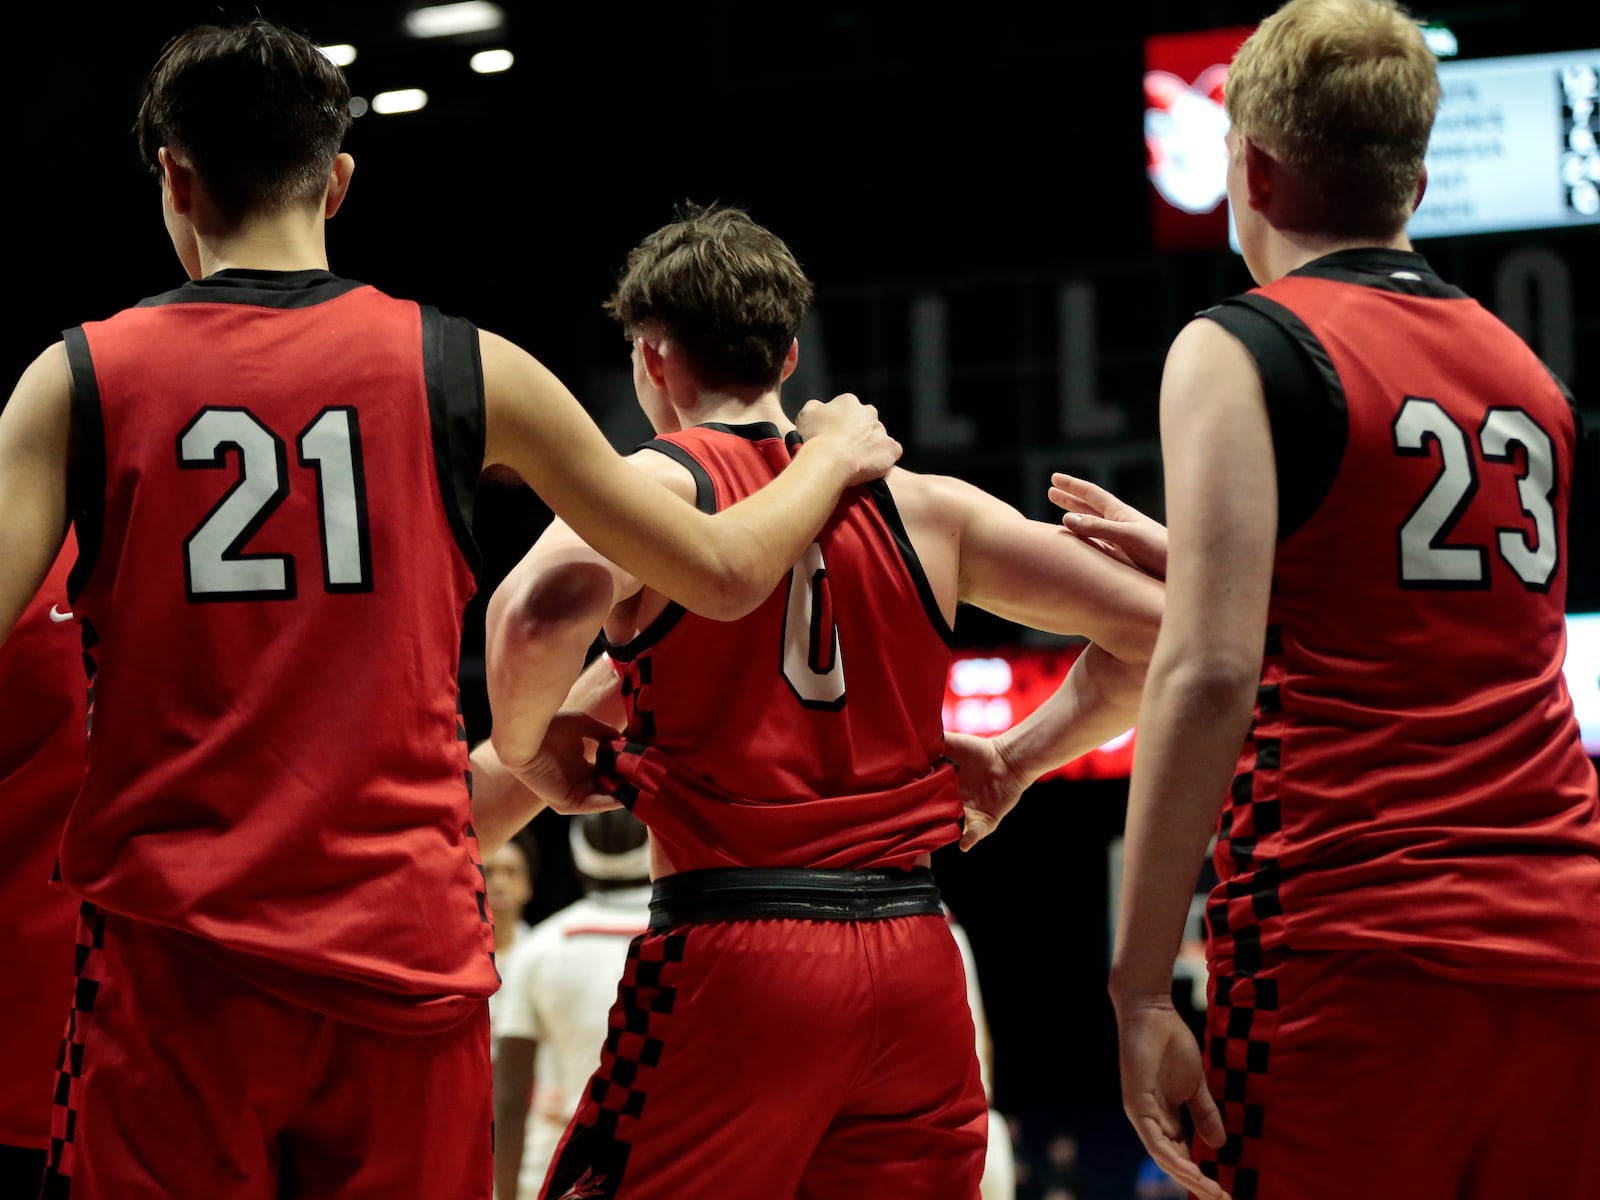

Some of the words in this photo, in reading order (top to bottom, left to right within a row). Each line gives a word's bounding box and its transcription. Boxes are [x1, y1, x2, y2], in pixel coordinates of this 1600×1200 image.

[176, 405, 374, 604] 21
[1391, 395, 1560, 593] 23
[779, 540, 847, 712] 0
